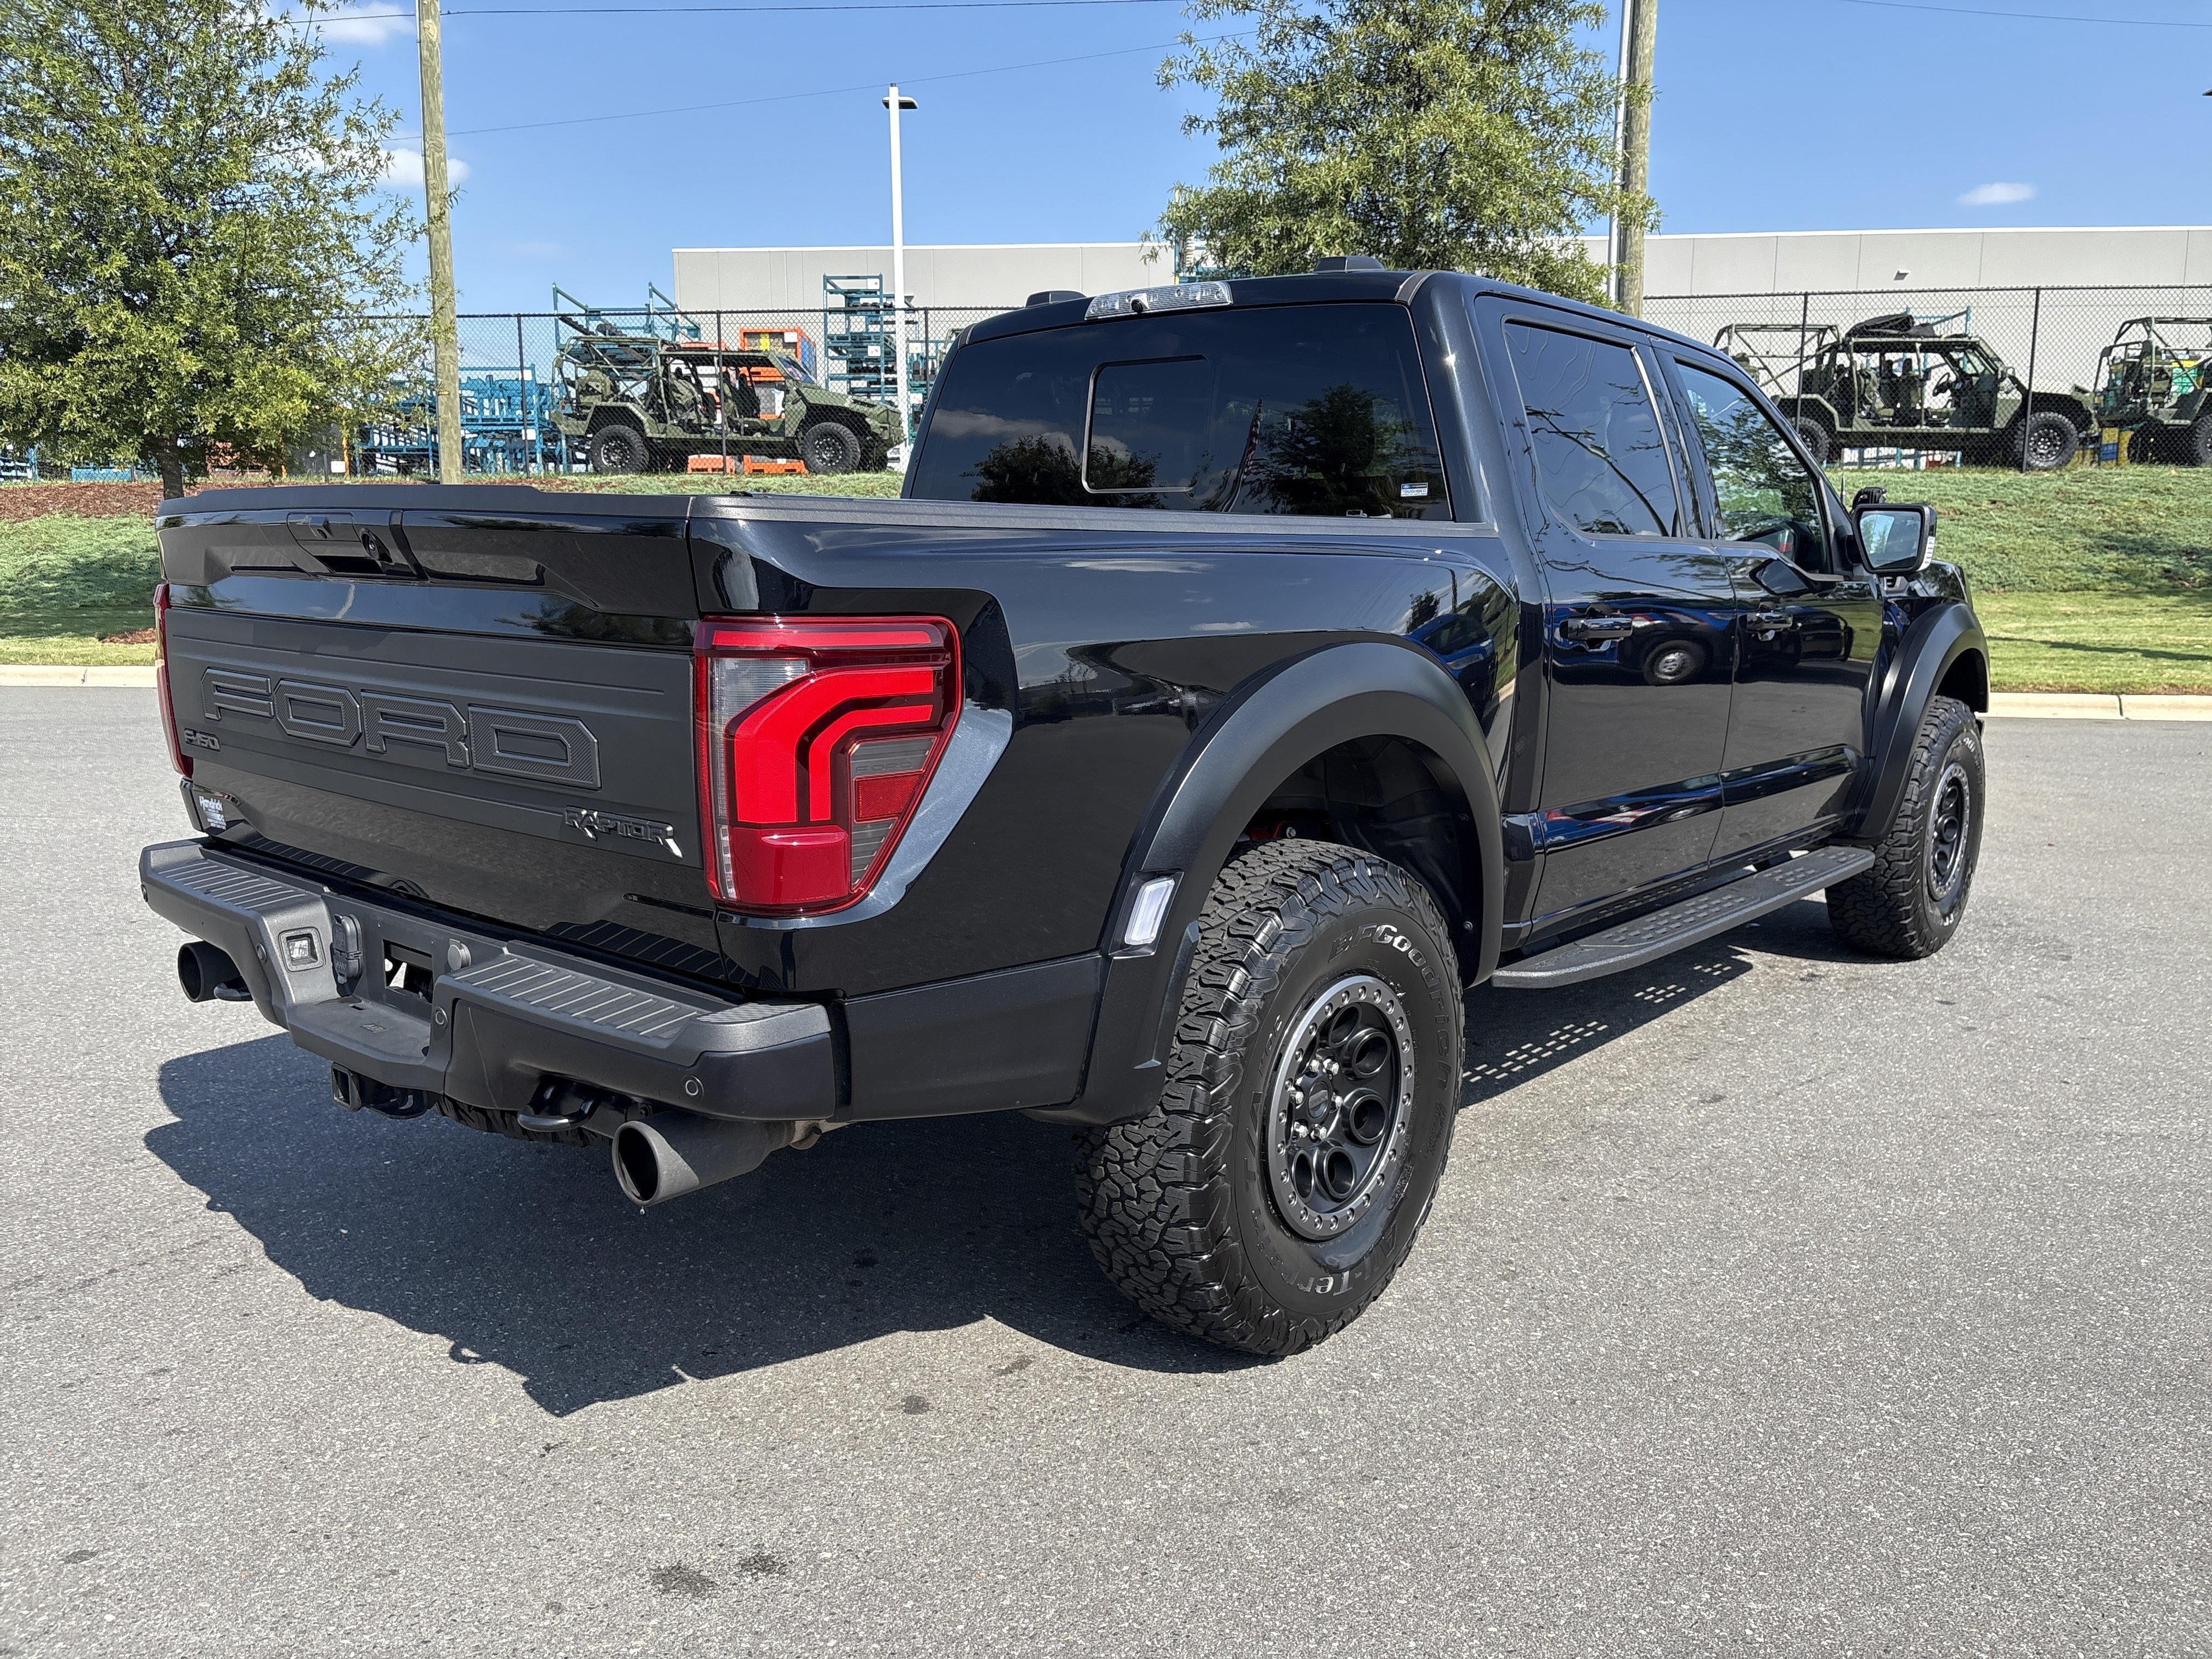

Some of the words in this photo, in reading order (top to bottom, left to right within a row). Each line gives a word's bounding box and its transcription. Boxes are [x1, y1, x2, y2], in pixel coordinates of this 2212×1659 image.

[201, 667, 602, 790] FORD
[856, 761, 913, 773] FORD
[565, 805, 684, 858] RAPTOR
[1328, 923, 1452, 1091] BFGoodrich
